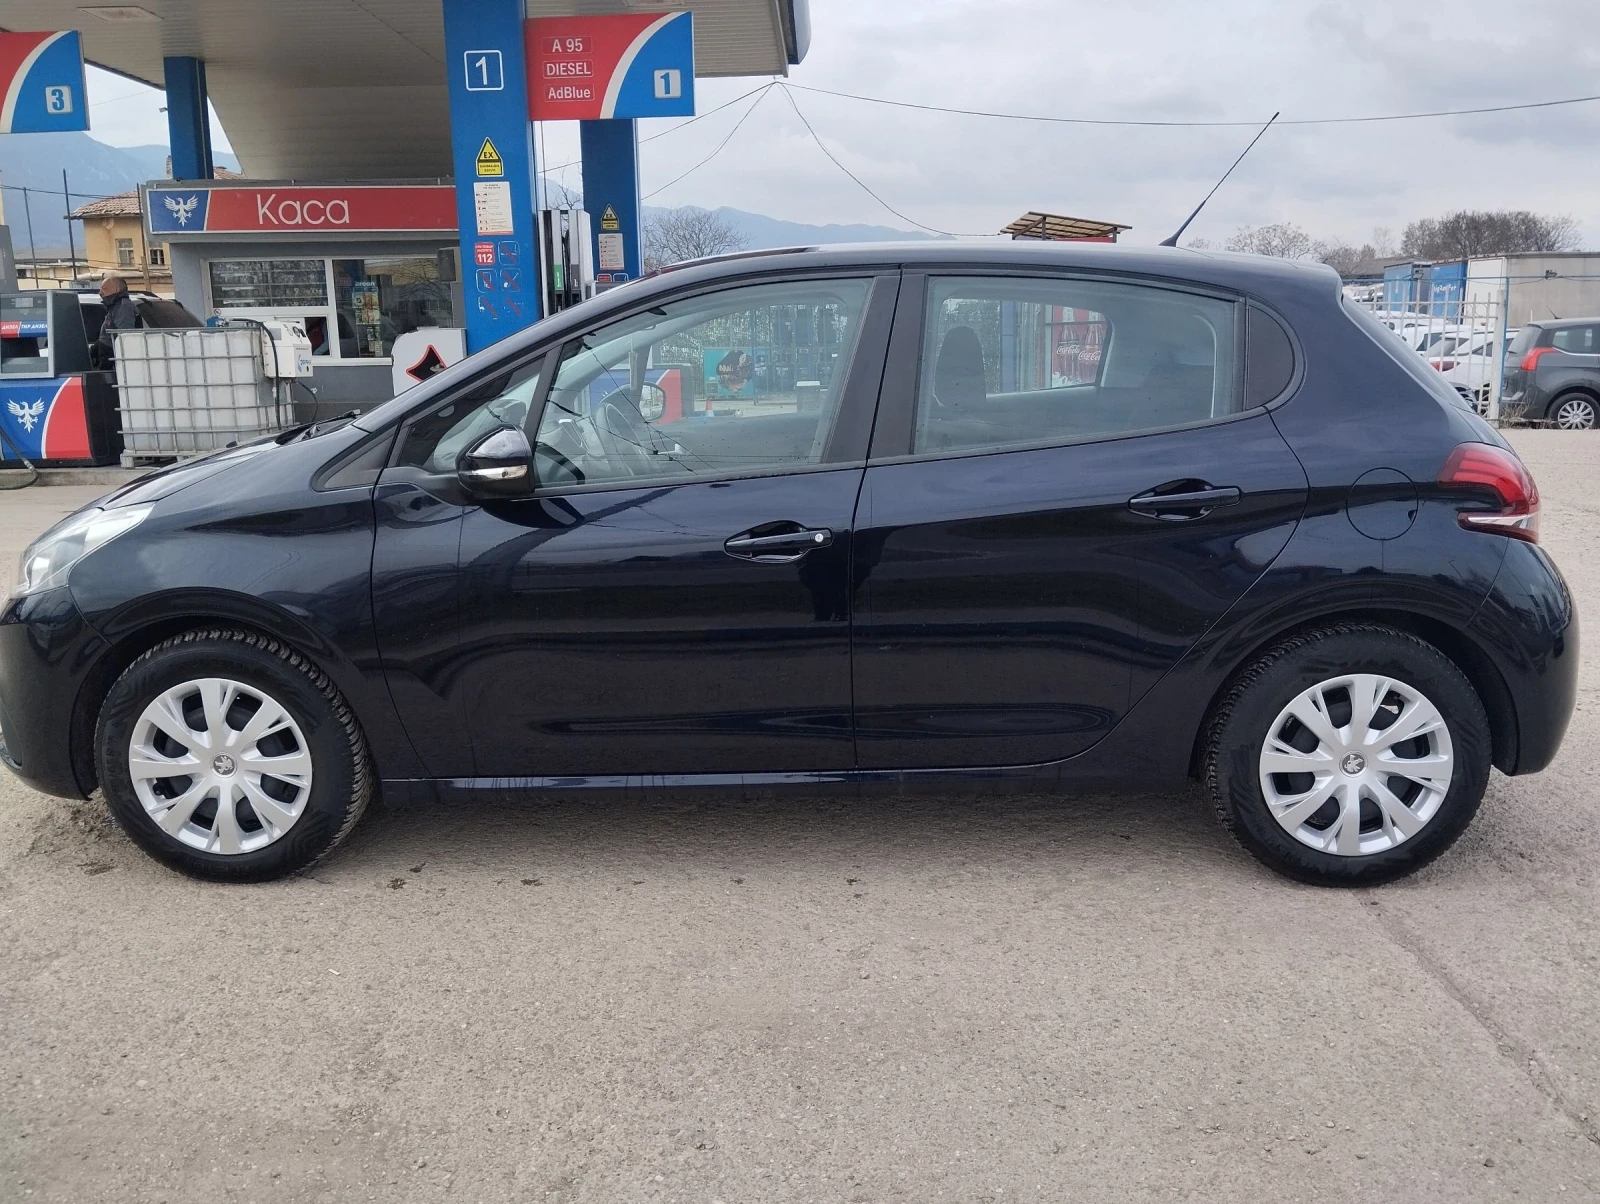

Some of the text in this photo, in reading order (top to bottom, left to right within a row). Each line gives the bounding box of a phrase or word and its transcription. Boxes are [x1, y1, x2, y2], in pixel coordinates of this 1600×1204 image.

[552, 38, 583, 53] A 95
[475, 56, 488, 85] 1
[546, 62, 591, 76] DIESEL
[548, 86, 591, 99] AdBlue
[660, 71, 671, 95] 1
[51, 88, 65, 111] 3
[256, 193, 350, 225] Каса
[477, 253, 493, 263] 112
